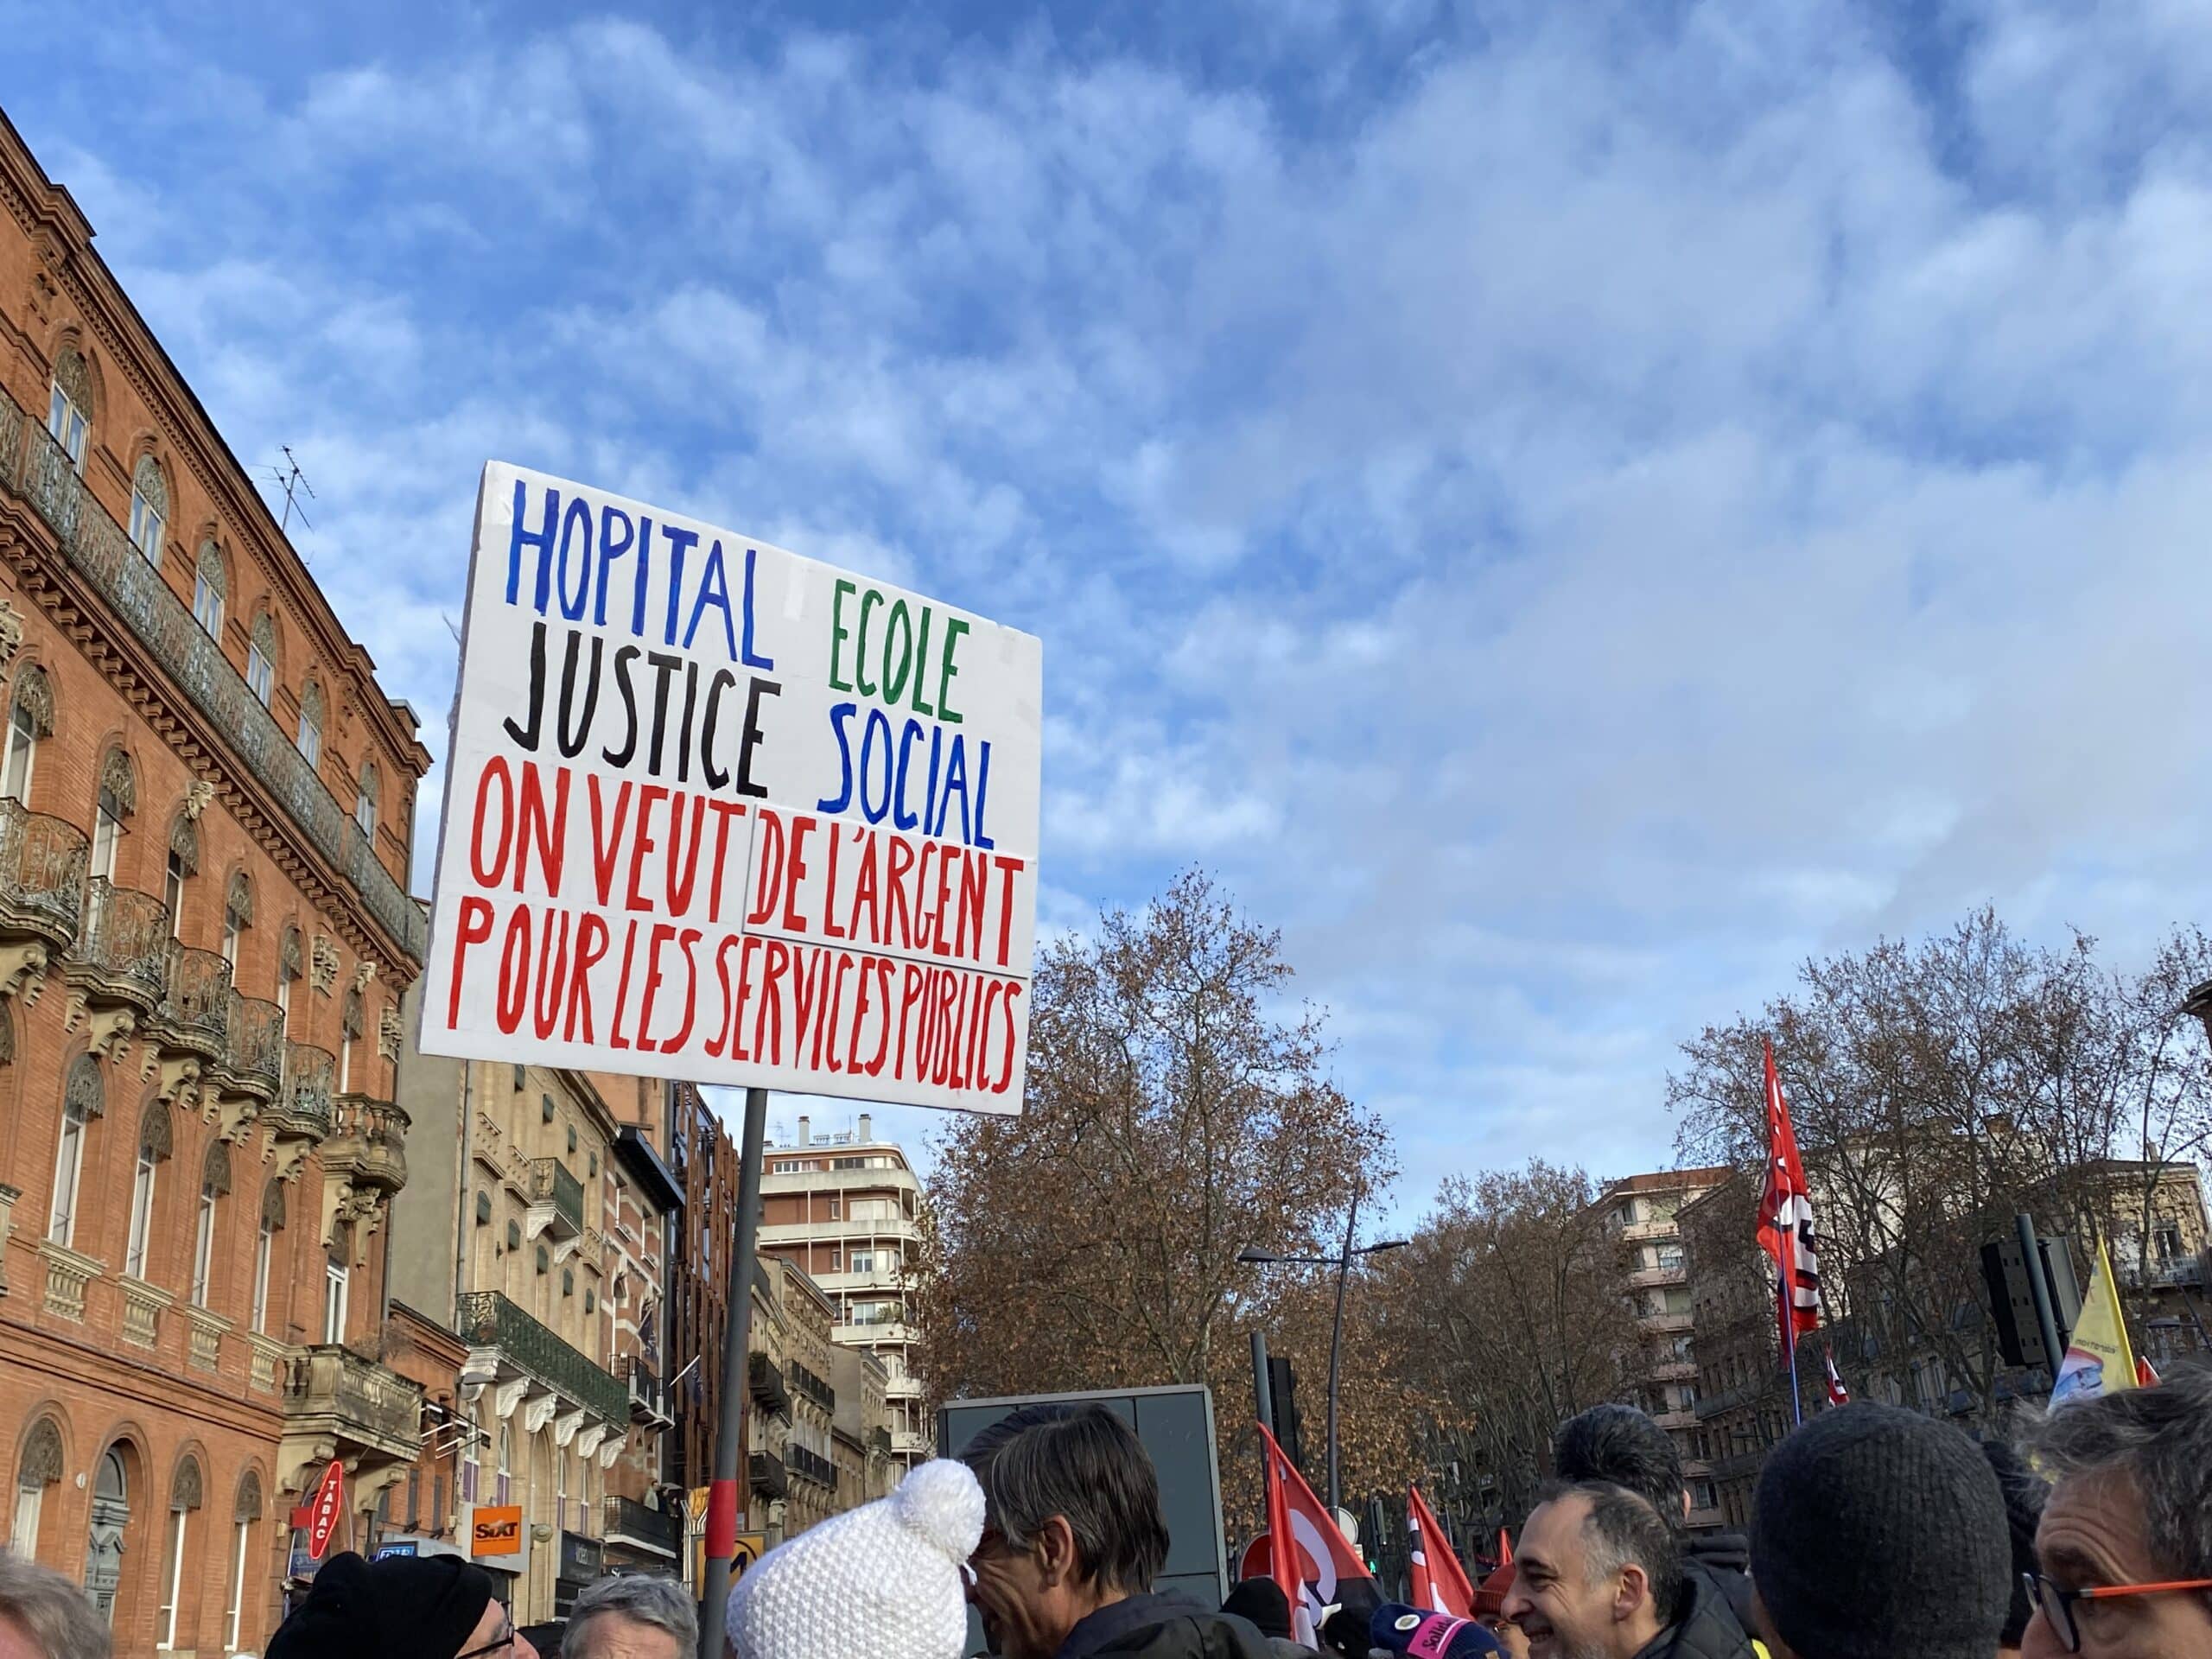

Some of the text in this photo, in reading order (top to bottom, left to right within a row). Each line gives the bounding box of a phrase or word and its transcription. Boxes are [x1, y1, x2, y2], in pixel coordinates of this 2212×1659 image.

[505, 480, 970, 724] HOPITAL ECOLE
[503, 621, 995, 850] JUSTICE SOCIAL
[470, 755, 1024, 967] ON VEUT DE L'ARGENT
[448, 895, 1023, 1094] POUR LES SERVICES PUBLICS
[315, 1480, 337, 1540] TABAC
